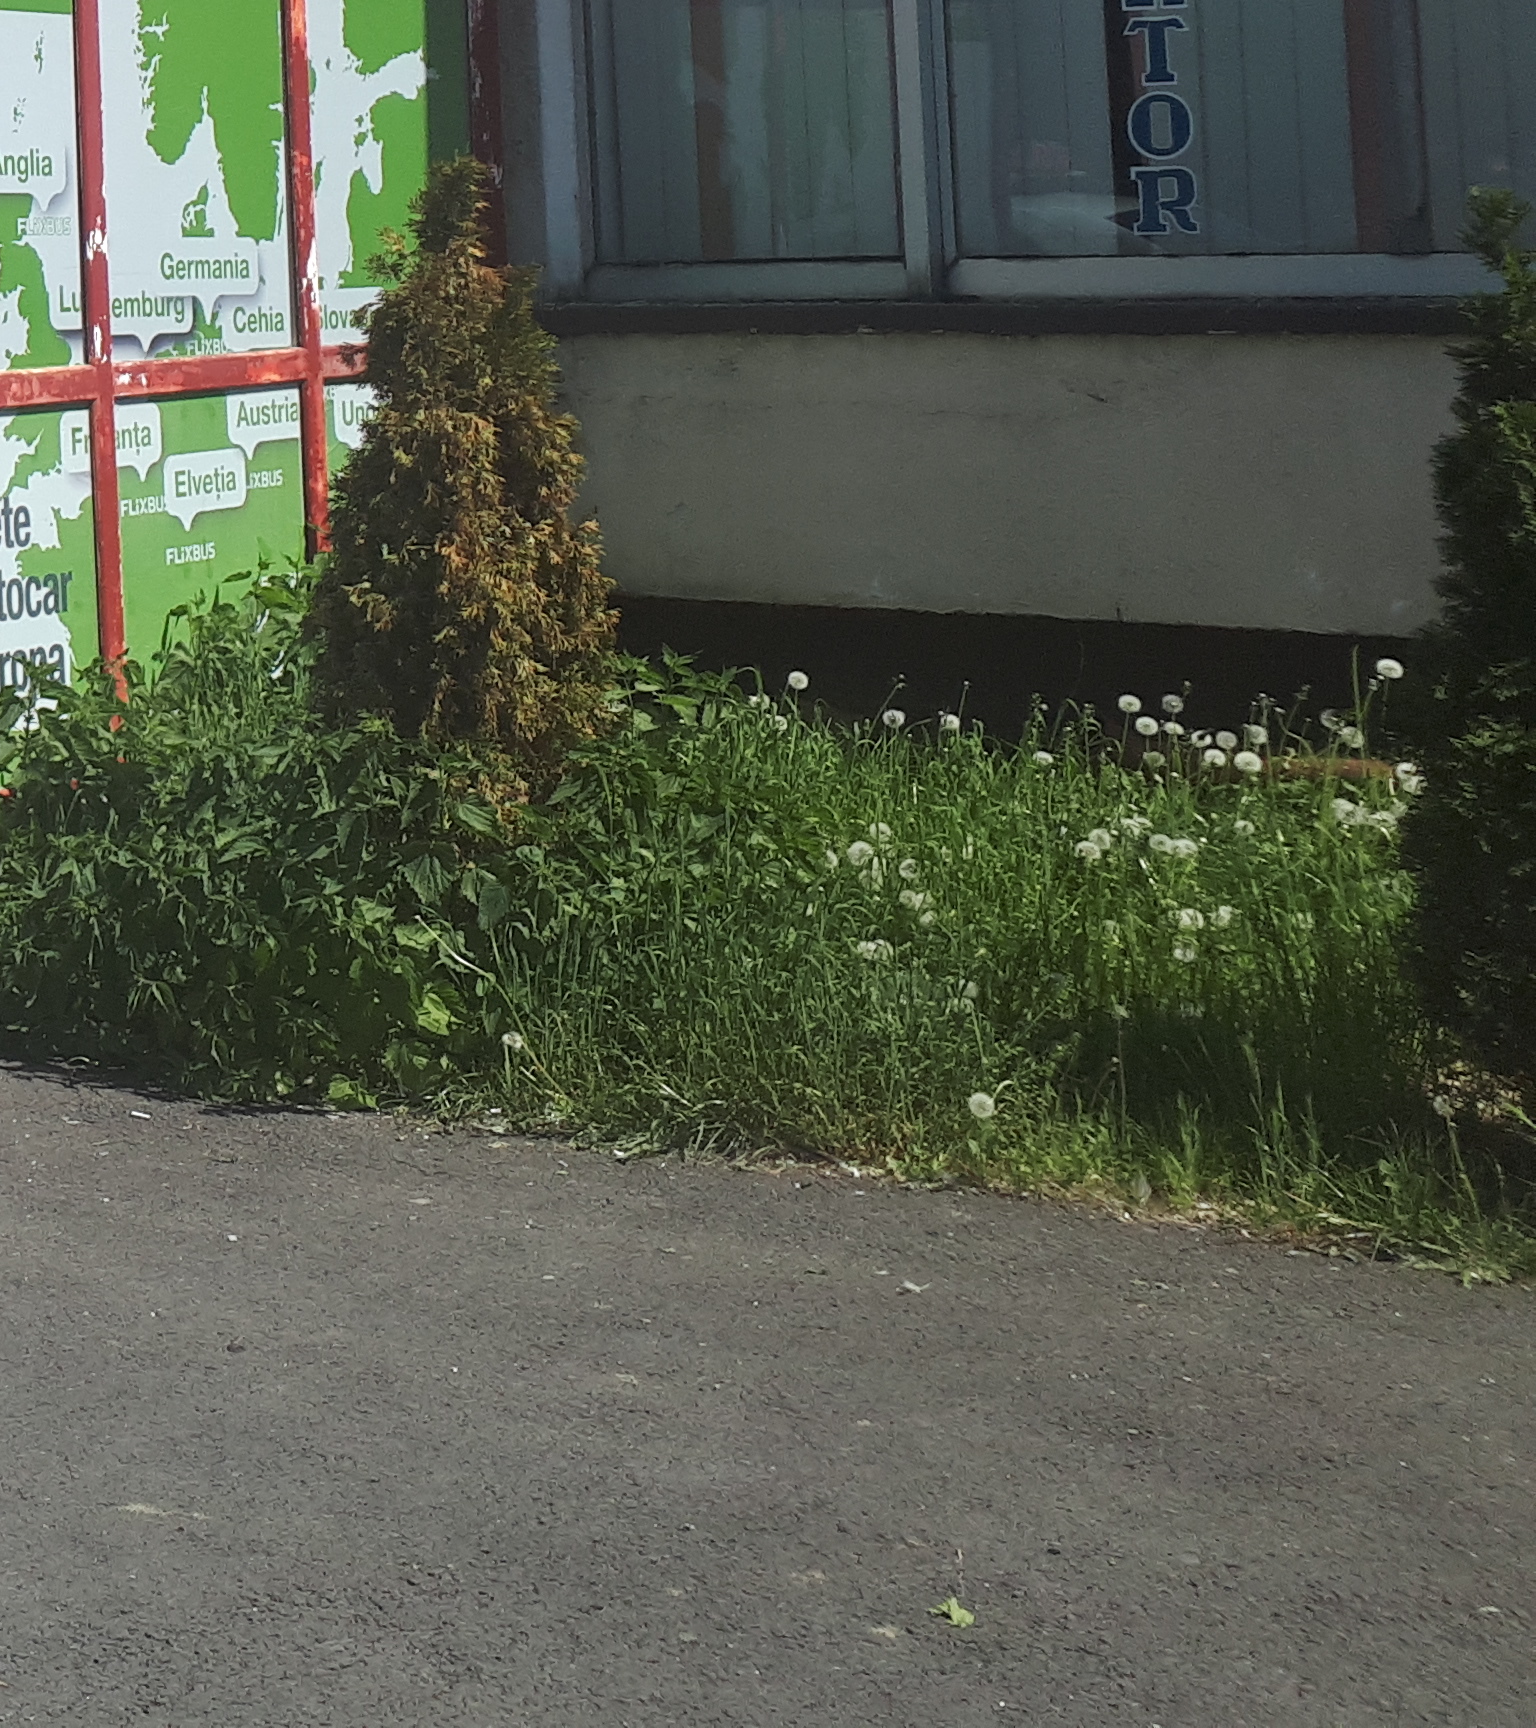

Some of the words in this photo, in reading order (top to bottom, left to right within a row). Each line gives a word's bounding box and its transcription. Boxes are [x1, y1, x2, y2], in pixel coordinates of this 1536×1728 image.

[159, 252, 251, 280] Germania
[59, 284, 186, 324] Luemburg
[232, 304, 285, 334] Cehia
[236, 395, 299, 428] Austria
[174, 464, 237, 501] Elveția
